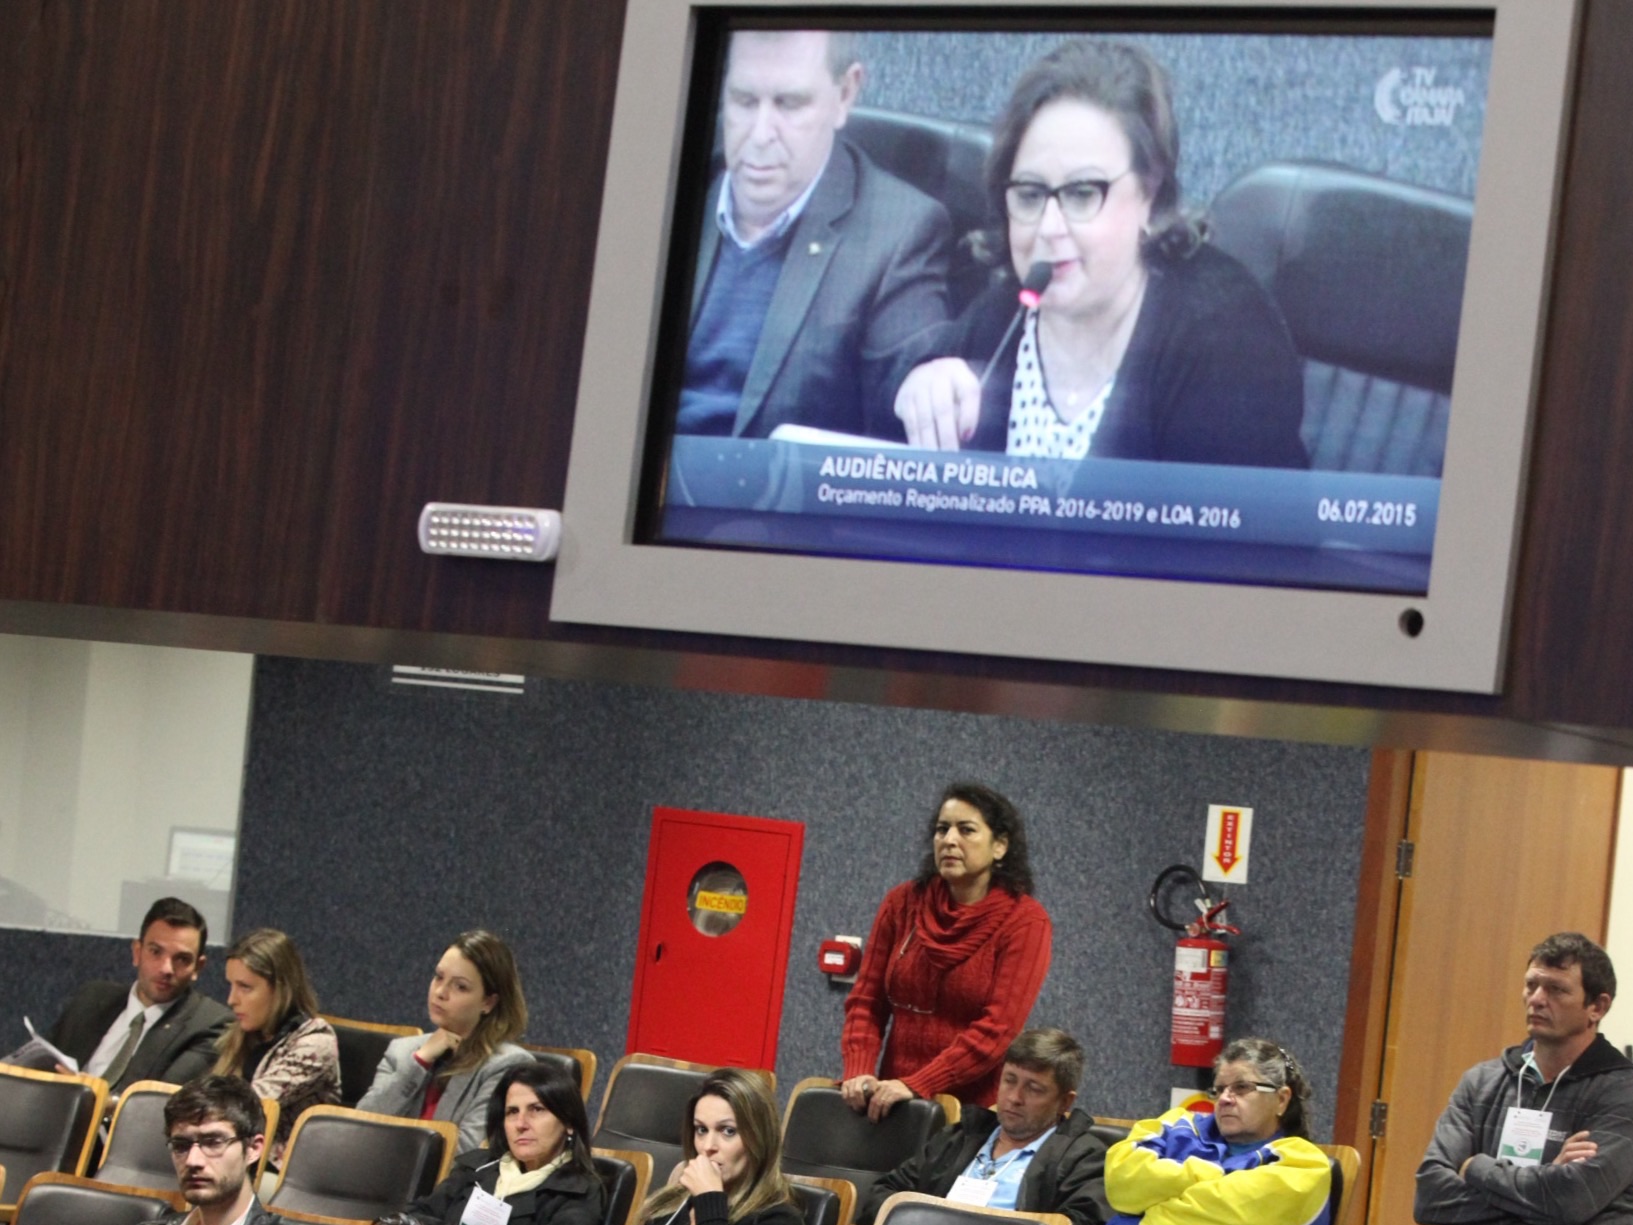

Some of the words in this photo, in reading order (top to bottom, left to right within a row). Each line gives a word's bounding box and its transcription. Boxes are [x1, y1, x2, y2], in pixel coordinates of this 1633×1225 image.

[1411, 66, 1437, 86] TV
[819, 453, 938, 483] AUDIÊNCIA
[942, 458, 1038, 489] PÚBLICA
[817, 483, 903, 507] Orçamento
[905, 488, 1016, 513] Regionalizado
[1018, 494, 1052, 517] PPA
[1055, 497, 1145, 522] 2016-2019
[1161, 504, 1195, 526] LOA
[1198, 506, 1241, 529] 2016
[1317, 497, 1417, 528] 06.07.2015
[1222, 814, 1235, 864] EXTINTOR
